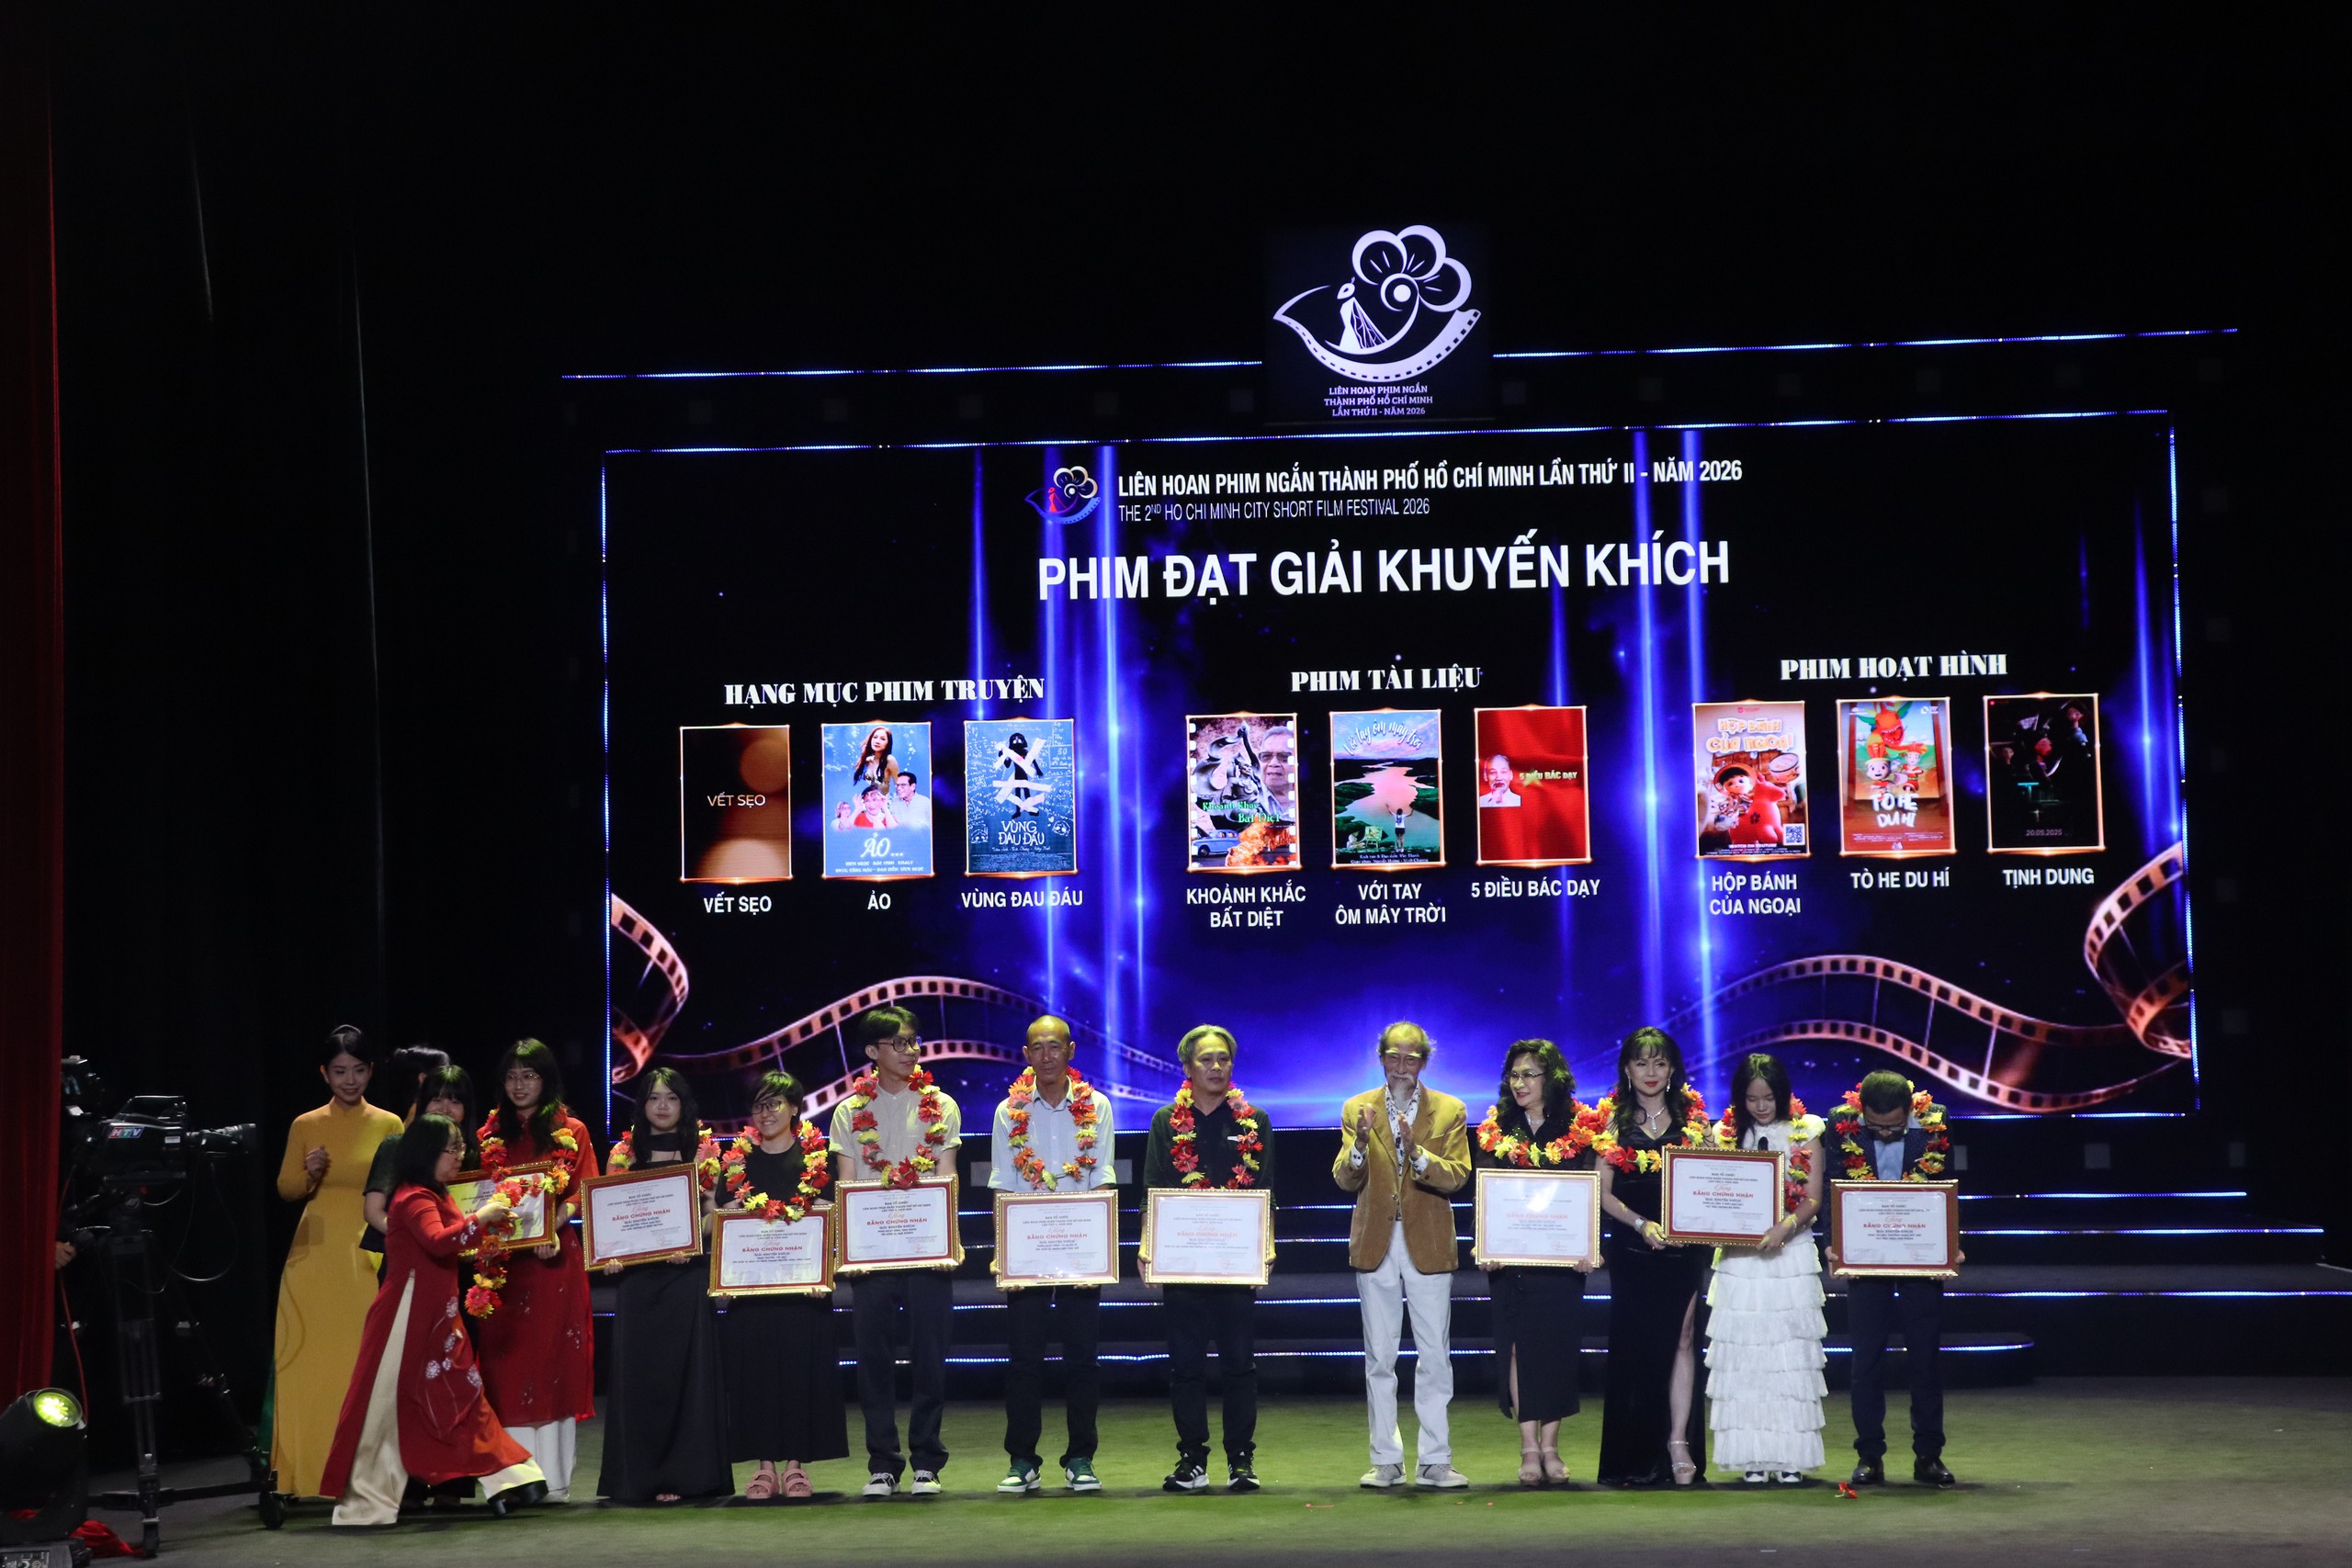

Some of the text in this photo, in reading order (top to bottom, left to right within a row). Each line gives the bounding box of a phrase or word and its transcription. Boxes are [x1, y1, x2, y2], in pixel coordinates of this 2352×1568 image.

[1324, 397, 1355, 406] THÀNH
[1357, 394, 1376, 405] PHỐ
[1378, 393, 1390, 404] HỒ
[1392, 395, 1407, 404] CHÍ
[1329, 385, 1348, 395] LIÊN
[1402, 382, 1428, 393] NGẮN
[1332, 406, 1350, 416] LẦN
[1351, 406, 1370, 416] THỨ
[1384, 406, 1404, 415] NĂM
[1118, 471, 1156, 496] LIÊN
[1162, 474, 1210, 496] HOAN
[1216, 473, 1260, 494] PHIM
[1266, 462, 1314, 493] NGẮN
[1318, 466, 1378, 491] THÀNH
[1384, 461, 1419, 490] PHỐ
[1424, 460, 1448, 488] HỒ
[1453, 462, 1483, 487] CHÍ
[1488, 465, 1534, 487] MINH
[1539, 457, 1574, 485] LẦN
[1578, 458, 1617, 484] THỨ
[1623, 463, 1634, 483] II
[1653, 456, 1694, 482] NĂM
[1699, 460, 1742, 481] 2026
[1118, 504, 1142, 521] THE
[1165, 503, 1182, 520] HO
[1186, 502, 1206, 520] CHI
[1210, 502, 1240, 519] MINH
[1244, 501, 1269, 519] CITY
[1273, 500, 1313, 518] SHORT
[1317, 499, 1344, 517] FILM
[1347, 497, 1399, 516] FESTIVAL
[1403, 497, 1430, 515] 2026
[1039, 529, 1729, 605] PHIM ĐẠT GIẢI KHUYẾN KHÍCH
[1781, 650, 2008, 682] PHIM HOẠT HÌNH
[1291, 663, 1481, 693] PHIM TÀI LIỆU
[724, 674, 1045, 709] HẠNG MỤC PHIM TRUYỆN
[1544, 770, 1561, 779] BÁC
[1562, 772, 1577, 780] DẠY
[707, 791, 766, 809] VẾT SẸO
[1001, 819, 1037, 833] VÙNG
[998, 831, 1045, 846] ĐAU ĐÁU
[1471, 875, 1601, 901] 5 ĐIỀU BÁC DẠY
[1712, 870, 1798, 893] HỘP BÁNH
[1850, 866, 1950, 889] TÒ HE DU HÍ
[2003, 868, 2095, 889] TỊNH DUNG
[867, 892, 891, 910] ẢO
[961, 887, 1084, 908] VÙNG ĐAU ĐÁU
[1186, 879, 1306, 905] KHOẢNH KHẮC
[1358, 880, 1422, 900] VỚI TAY
[703, 891, 772, 915] VẾT SẸO
[1710, 894, 1801, 916] CỦA NGOẠI
[1210, 906, 1284, 930] BẤT DIỆT
[1335, 904, 1447, 926] ÔM MÂY TRỜI
[112, 1128, 141, 1137] HTV
